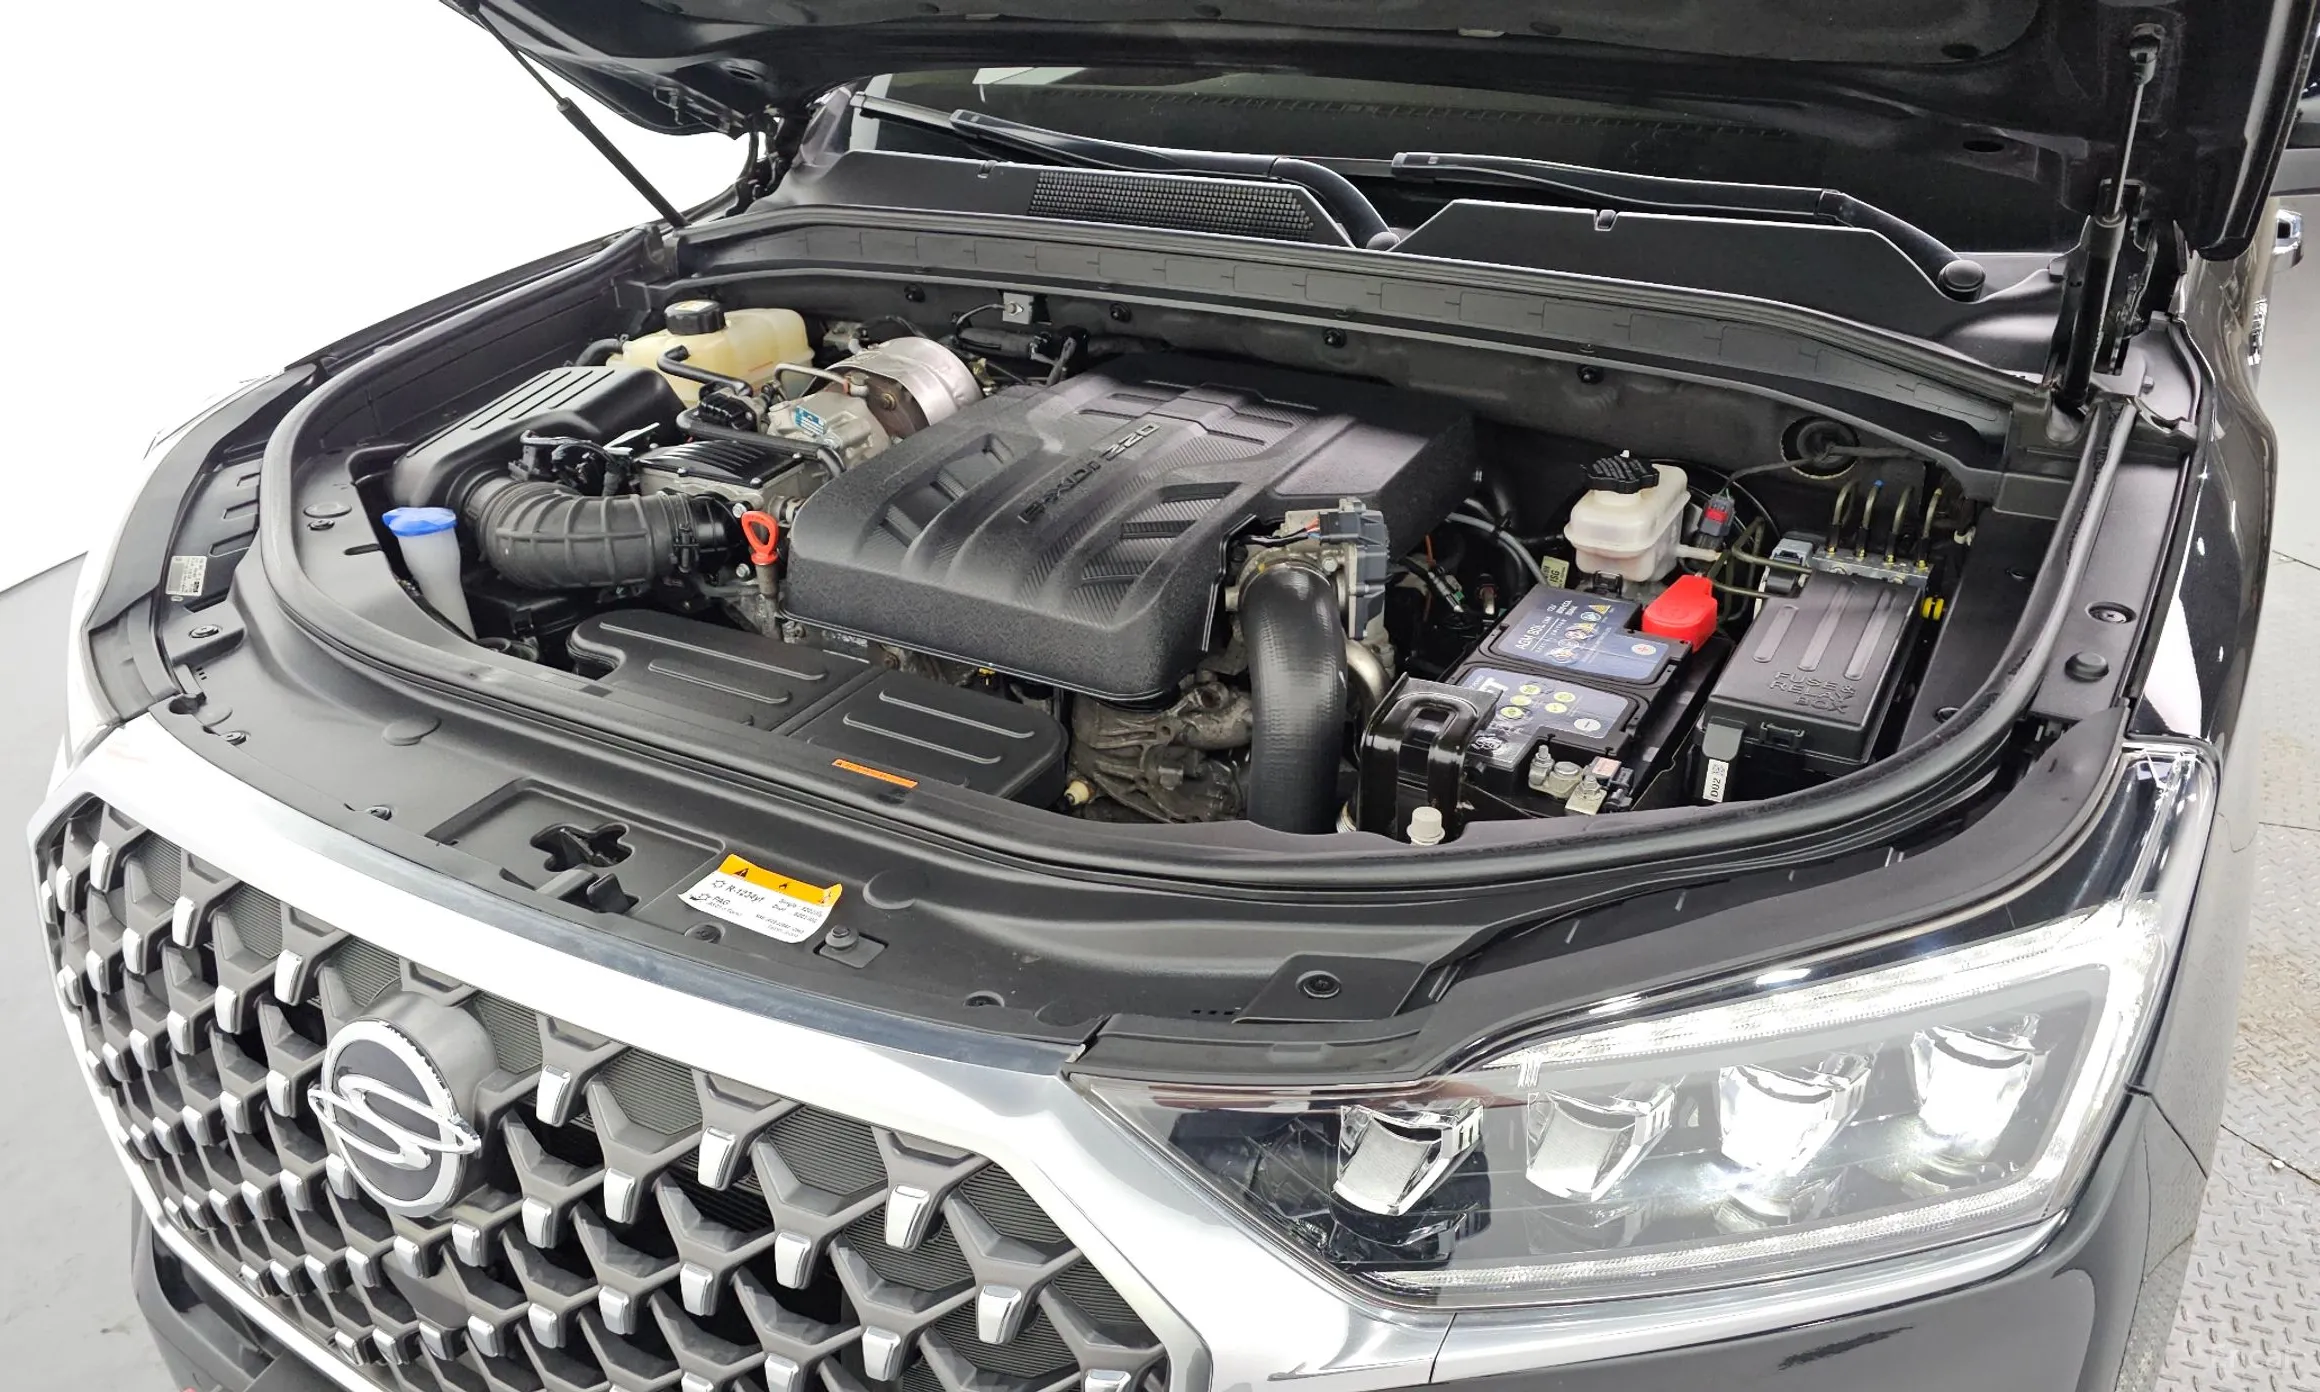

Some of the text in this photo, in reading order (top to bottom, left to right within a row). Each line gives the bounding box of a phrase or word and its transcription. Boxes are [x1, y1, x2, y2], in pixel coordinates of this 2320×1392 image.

[1101, 422, 1162, 461] 220
[1769, 680, 1856, 701] RELAY
[1774, 671, 1856, 694] FUSE &
[1794, 696, 1849, 714] BOX
